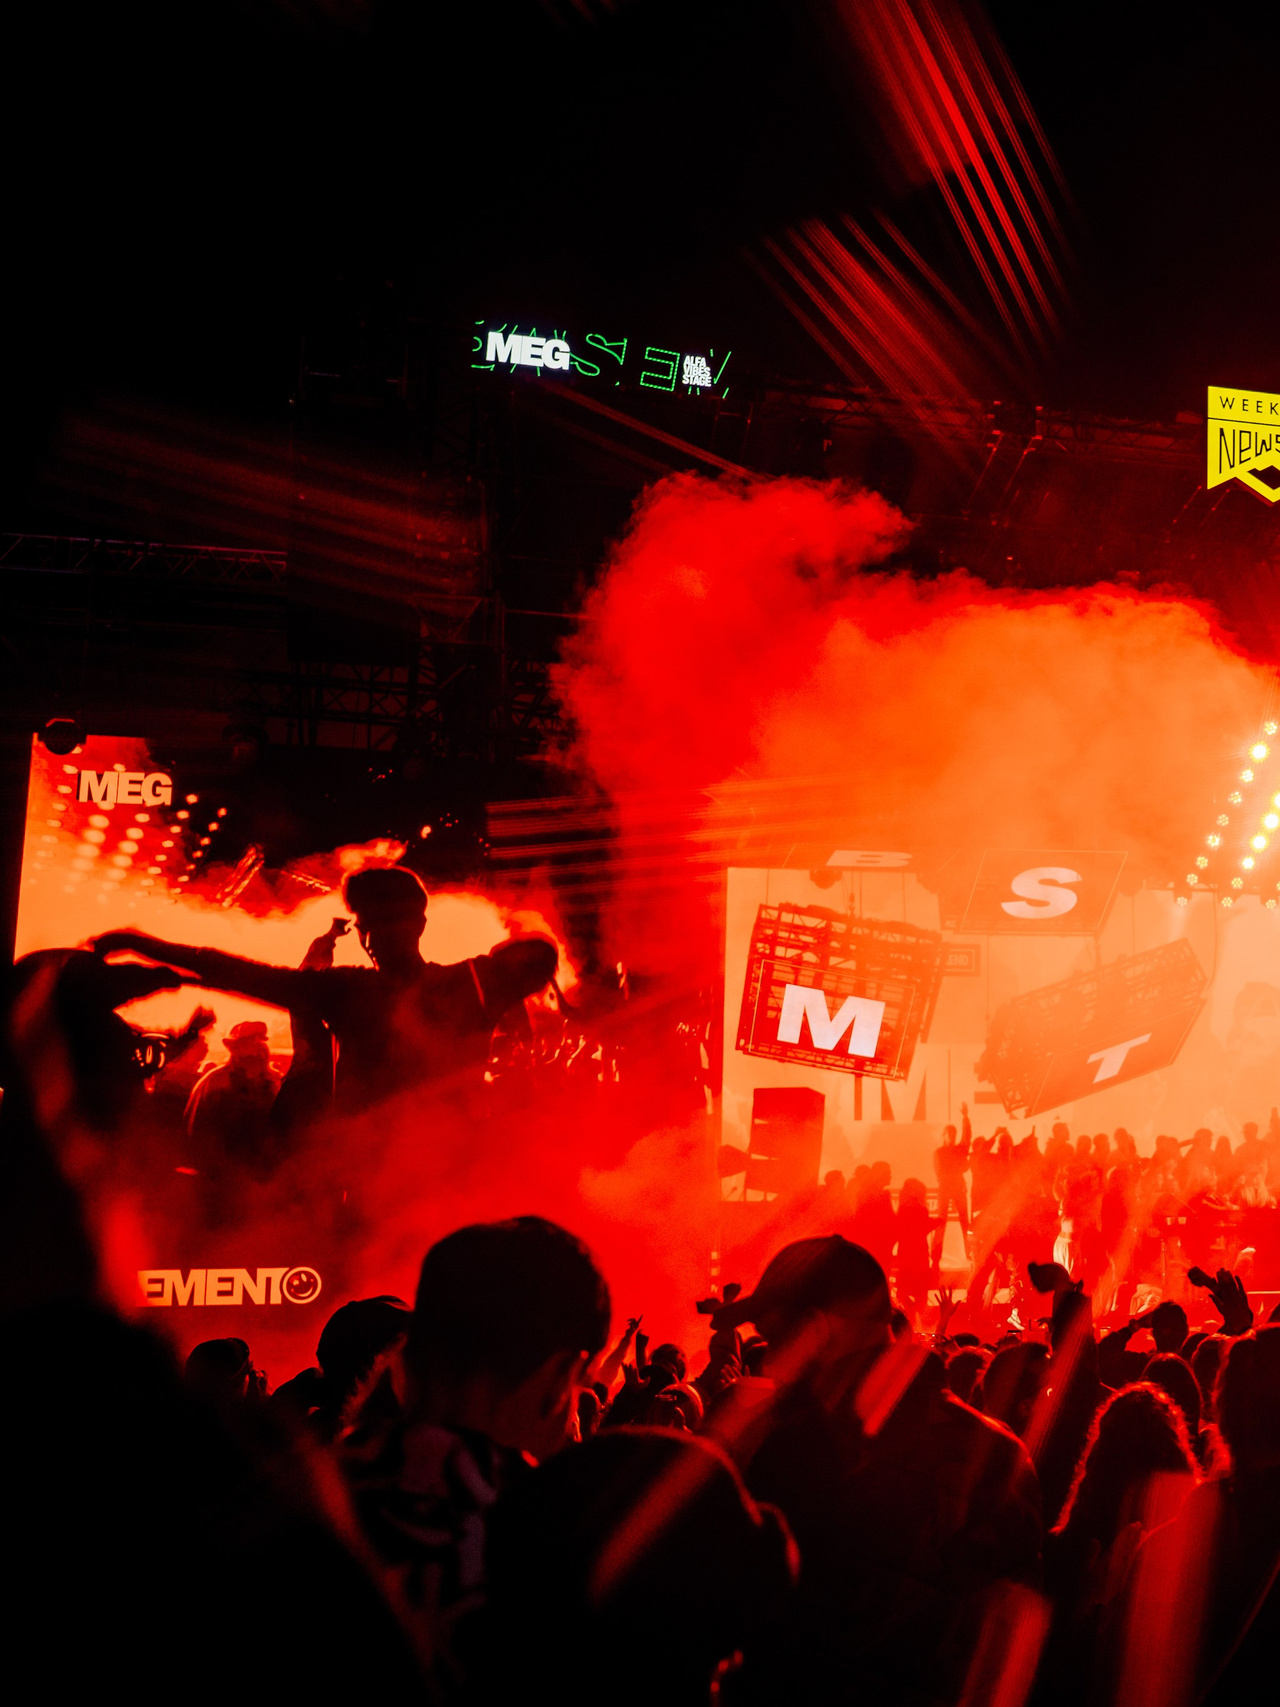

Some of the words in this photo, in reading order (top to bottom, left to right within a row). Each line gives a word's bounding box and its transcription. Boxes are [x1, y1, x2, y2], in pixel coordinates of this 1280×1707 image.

[486, 331, 571, 370] MEG
[683, 355, 706, 368] ALFA
[682, 374, 712, 387] STAGE
[684, 364, 711, 377] VIBES
[79, 770, 172, 806] MEG
[825, 849, 913, 868] B
[1001, 866, 1083, 919] S
[777, 983, 886, 1059] M
[1087, 1033, 1152, 1083] T
